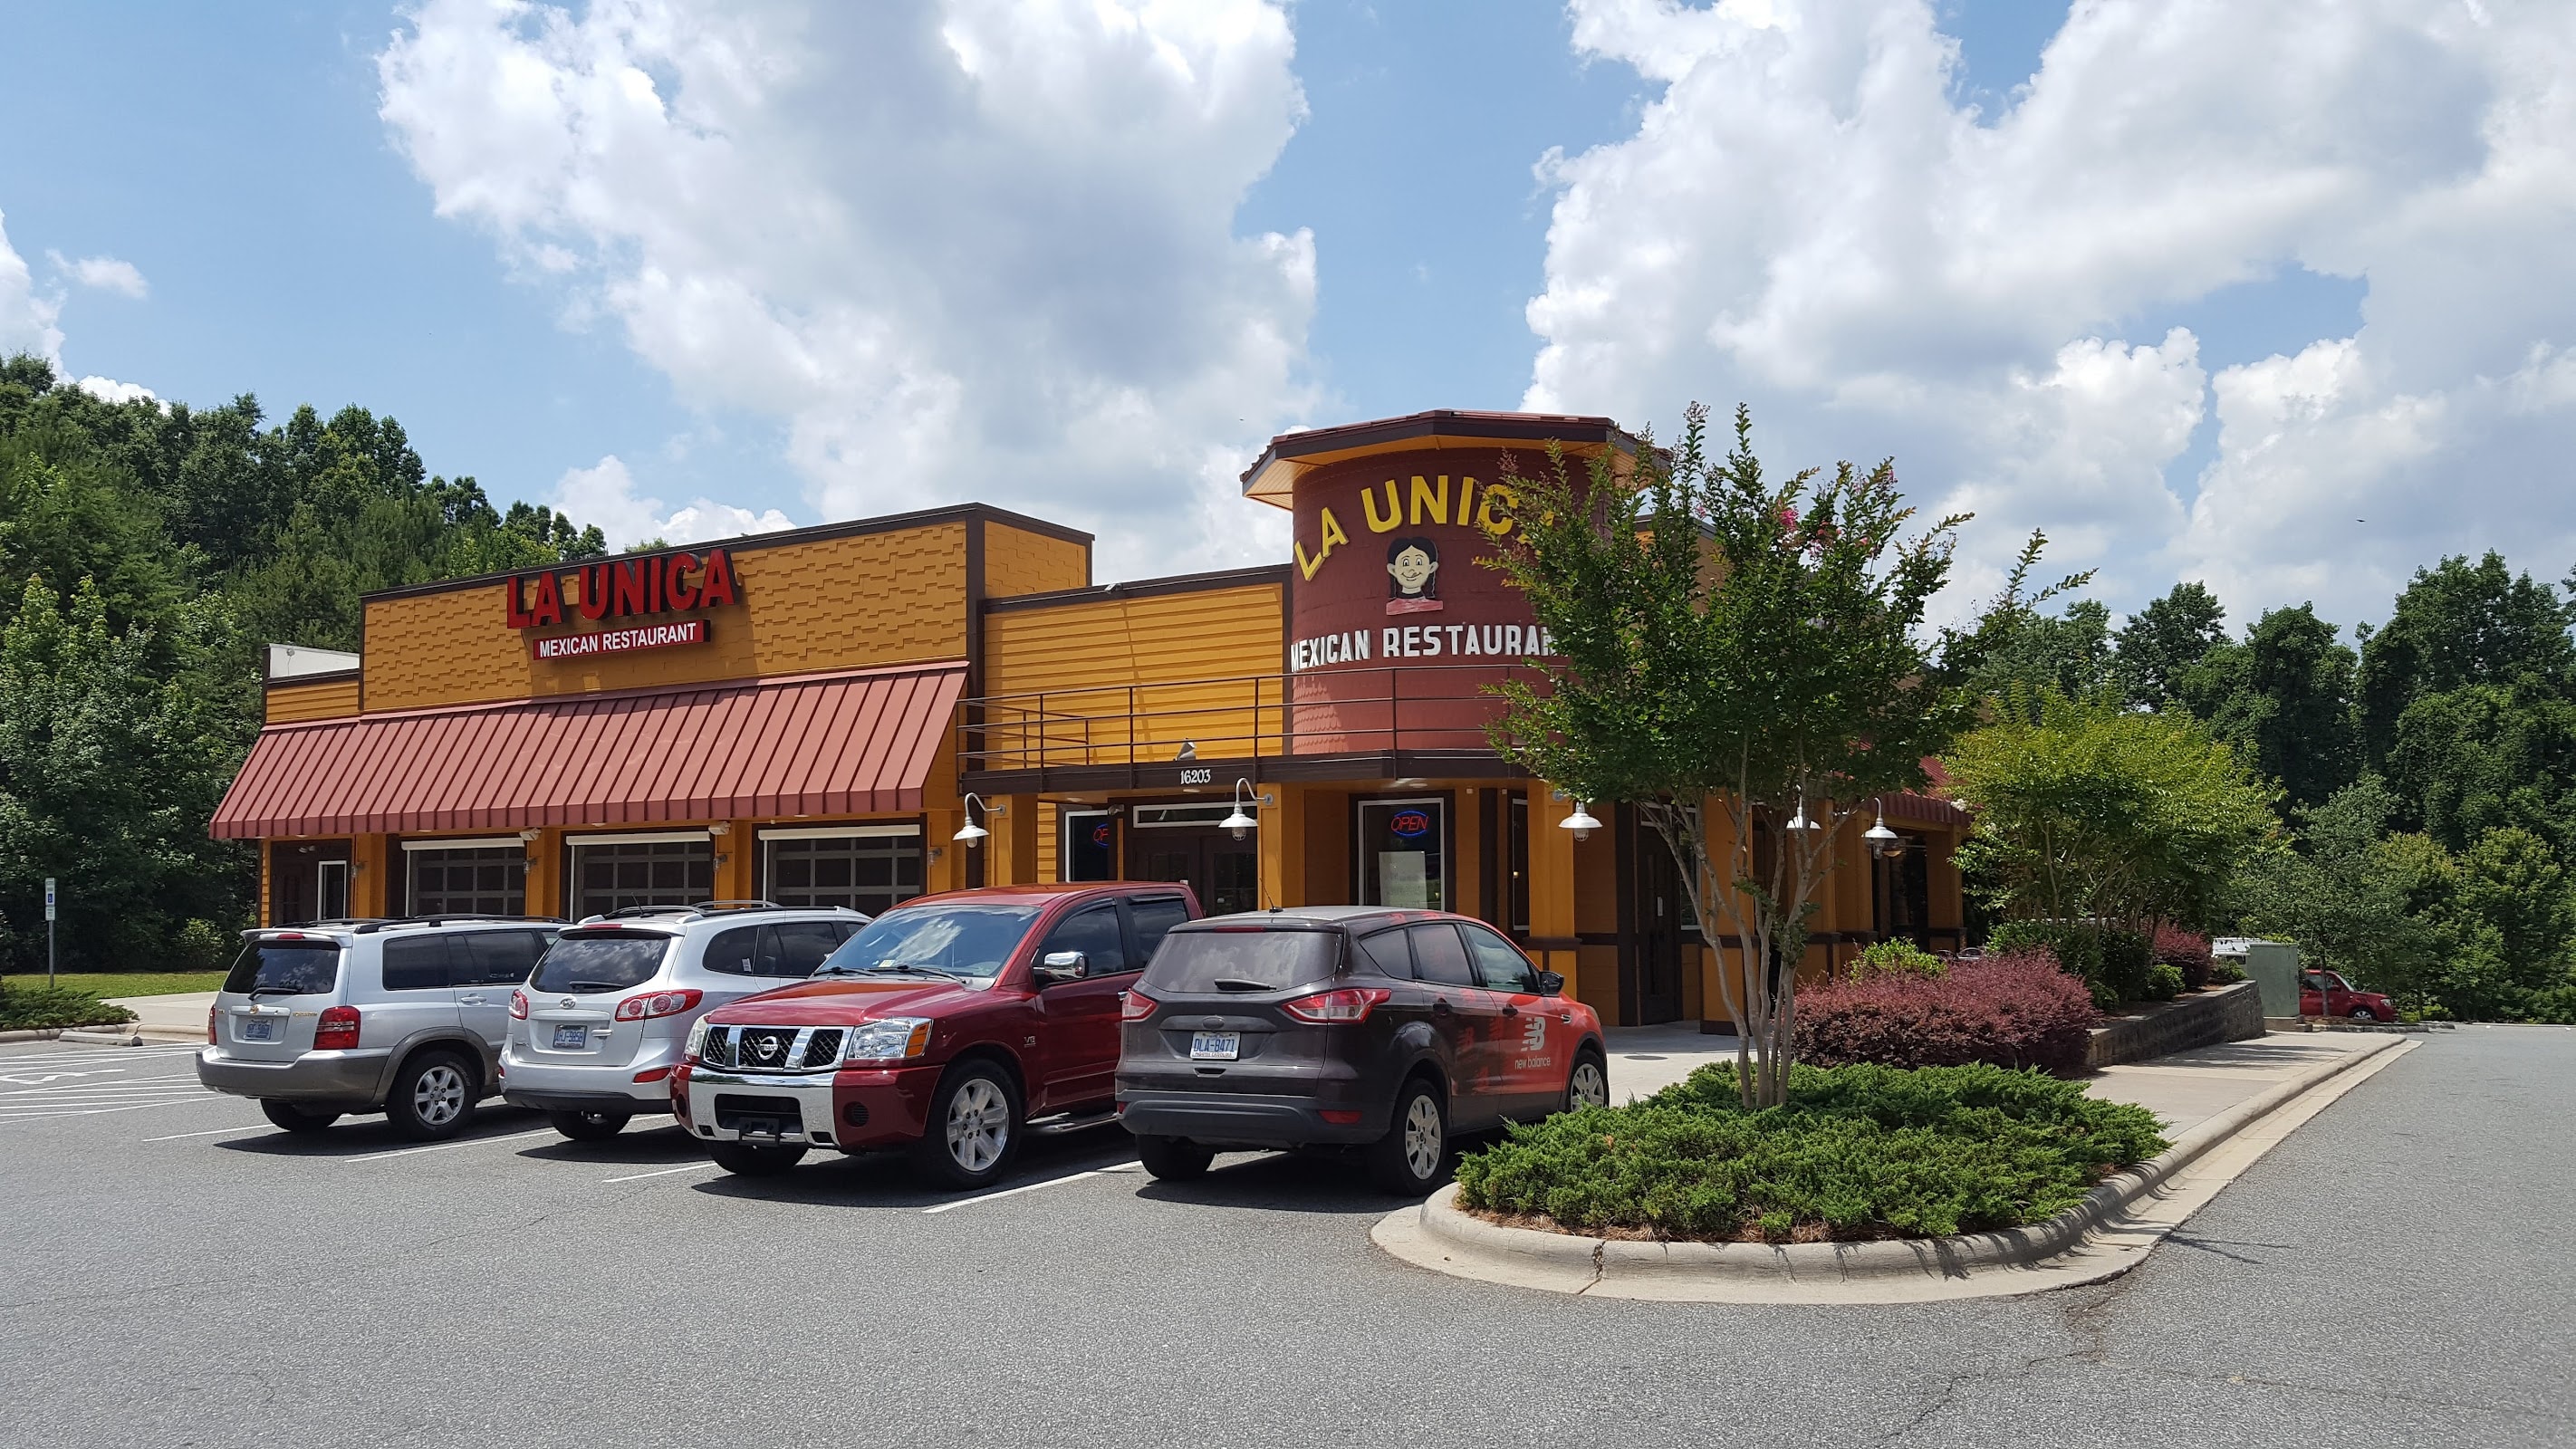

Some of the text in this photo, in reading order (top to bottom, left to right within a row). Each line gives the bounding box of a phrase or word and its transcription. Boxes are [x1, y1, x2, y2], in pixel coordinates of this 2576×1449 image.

[1294, 475, 1555, 581] LA UNIC
[507, 549, 735, 629] LA UNICA
[539, 622, 697, 658] MEXICAN RESTAURANT
[1291, 625, 1569, 672] MEXICAN RESTAURAN
[1180, 769, 1211, 784] 16203
[1391, 816, 1428, 831] OPEN
[1193, 1038, 1235, 1052] DLA-8471
[1514, 1056, 1552, 1070] new balance
